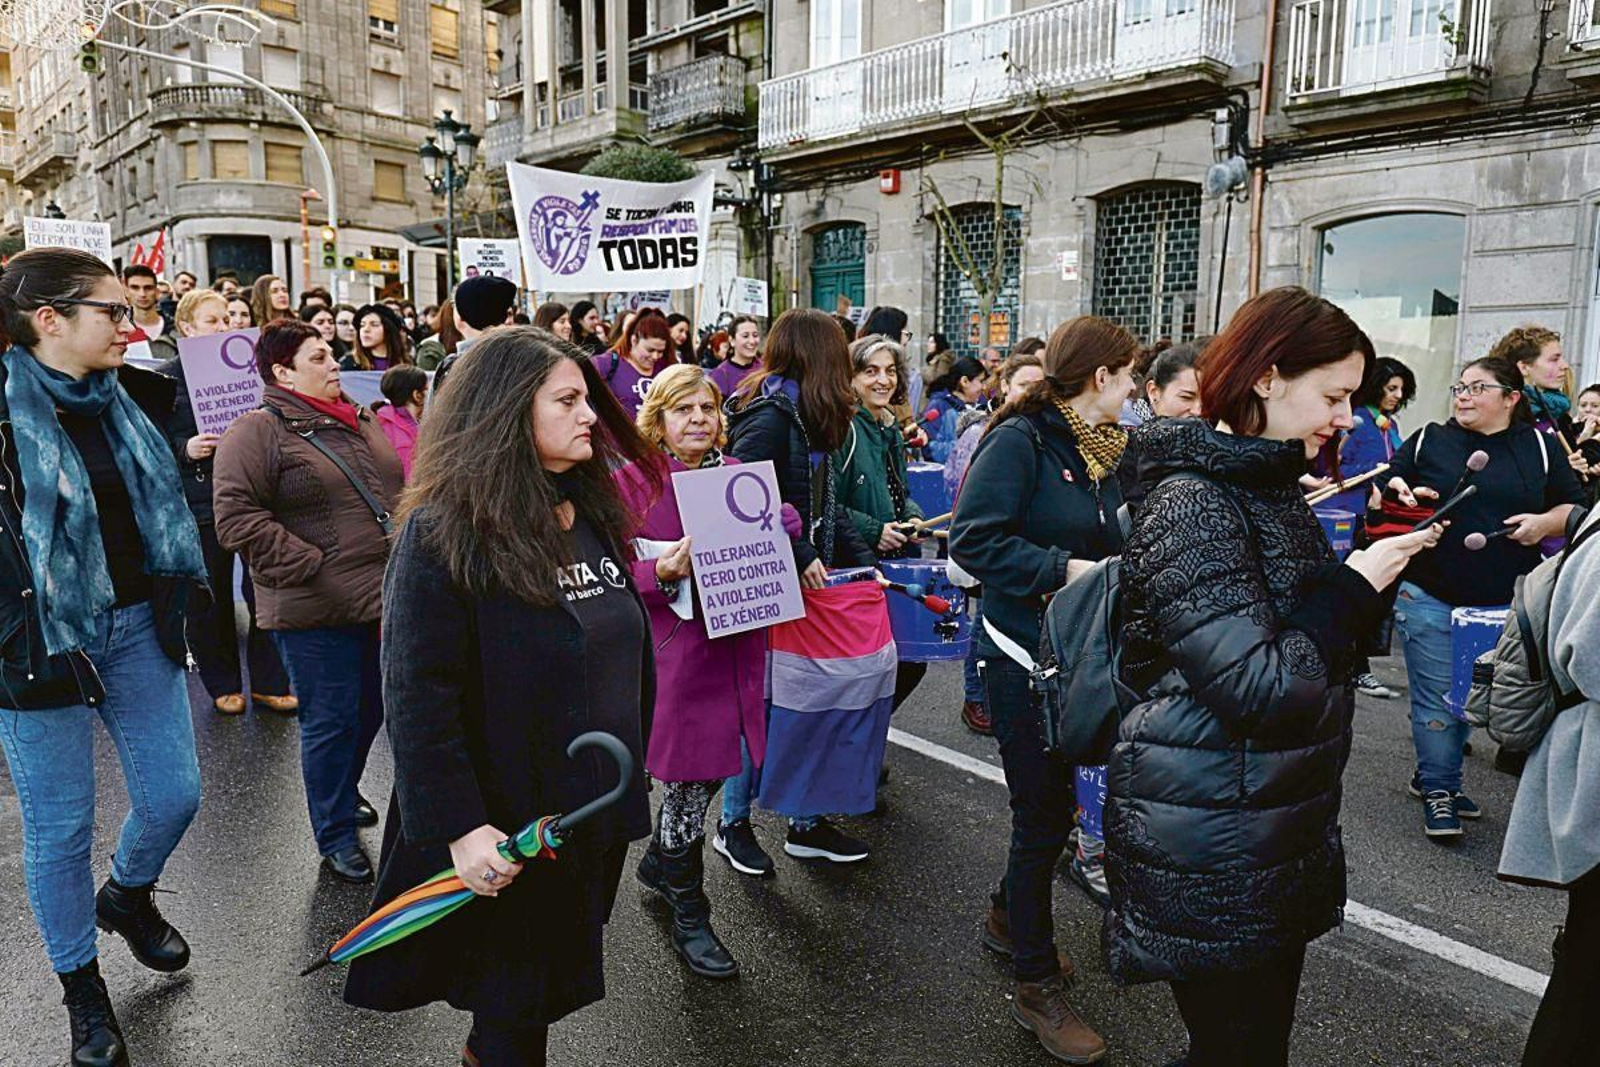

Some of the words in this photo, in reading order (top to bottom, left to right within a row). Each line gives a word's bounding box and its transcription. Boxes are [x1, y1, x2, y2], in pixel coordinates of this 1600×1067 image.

[605, 207, 622, 221] SE
[55, 223, 76, 234] SON
[597, 236, 699, 271] TODAS
[195, 388, 204, 399] A
[203, 379, 259, 397] VIOLENCIA
[197, 400, 214, 412] DE
[695, 540, 777, 567] TOLERANCIA
[701, 568, 737, 588] CERO
[738, 559, 788, 581] CONTRA
[575, 586, 605, 600] barco
[707, 595, 717, 610] A
[716, 581, 785, 607] VIOLENCIA
[711, 614, 730, 631] DE
[730, 603, 781, 626] XÉNERO
